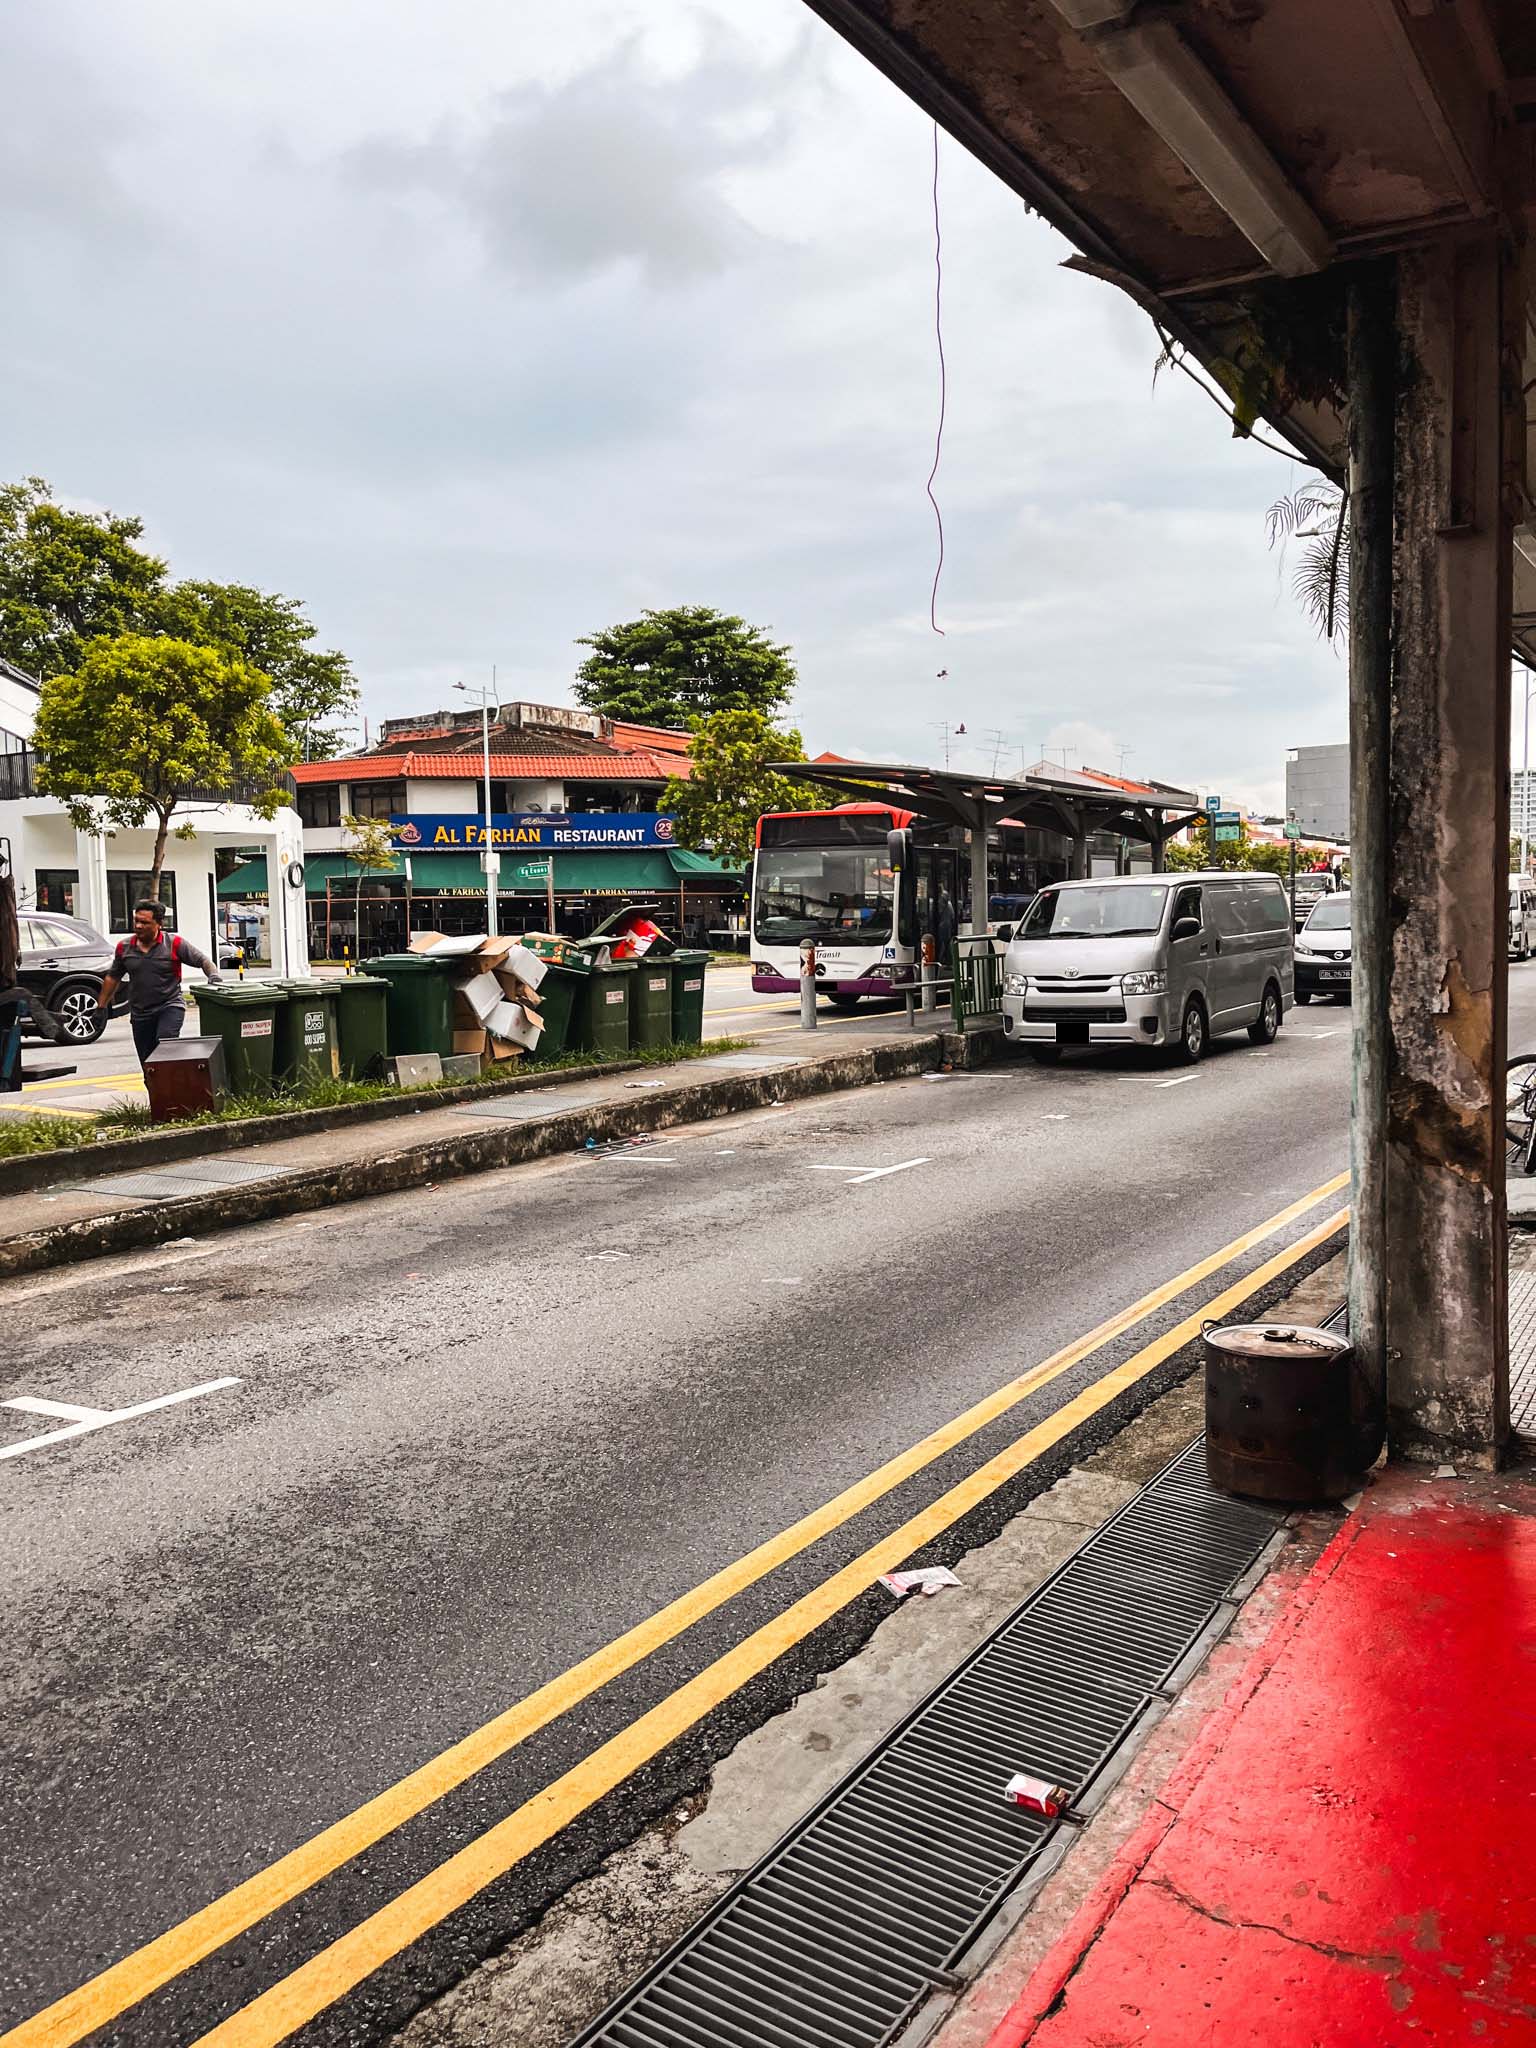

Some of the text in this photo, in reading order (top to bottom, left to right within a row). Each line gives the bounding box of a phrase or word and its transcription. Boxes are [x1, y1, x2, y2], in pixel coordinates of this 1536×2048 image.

[657, 822, 672, 833] 23
[554, 829, 645, 842] RESTAURANT
[438, 888, 450, 896] AL
[452, 888, 486, 896] FARHAN
[582, 888, 591, 896] AL
[596, 888, 628, 896] FARHAN
